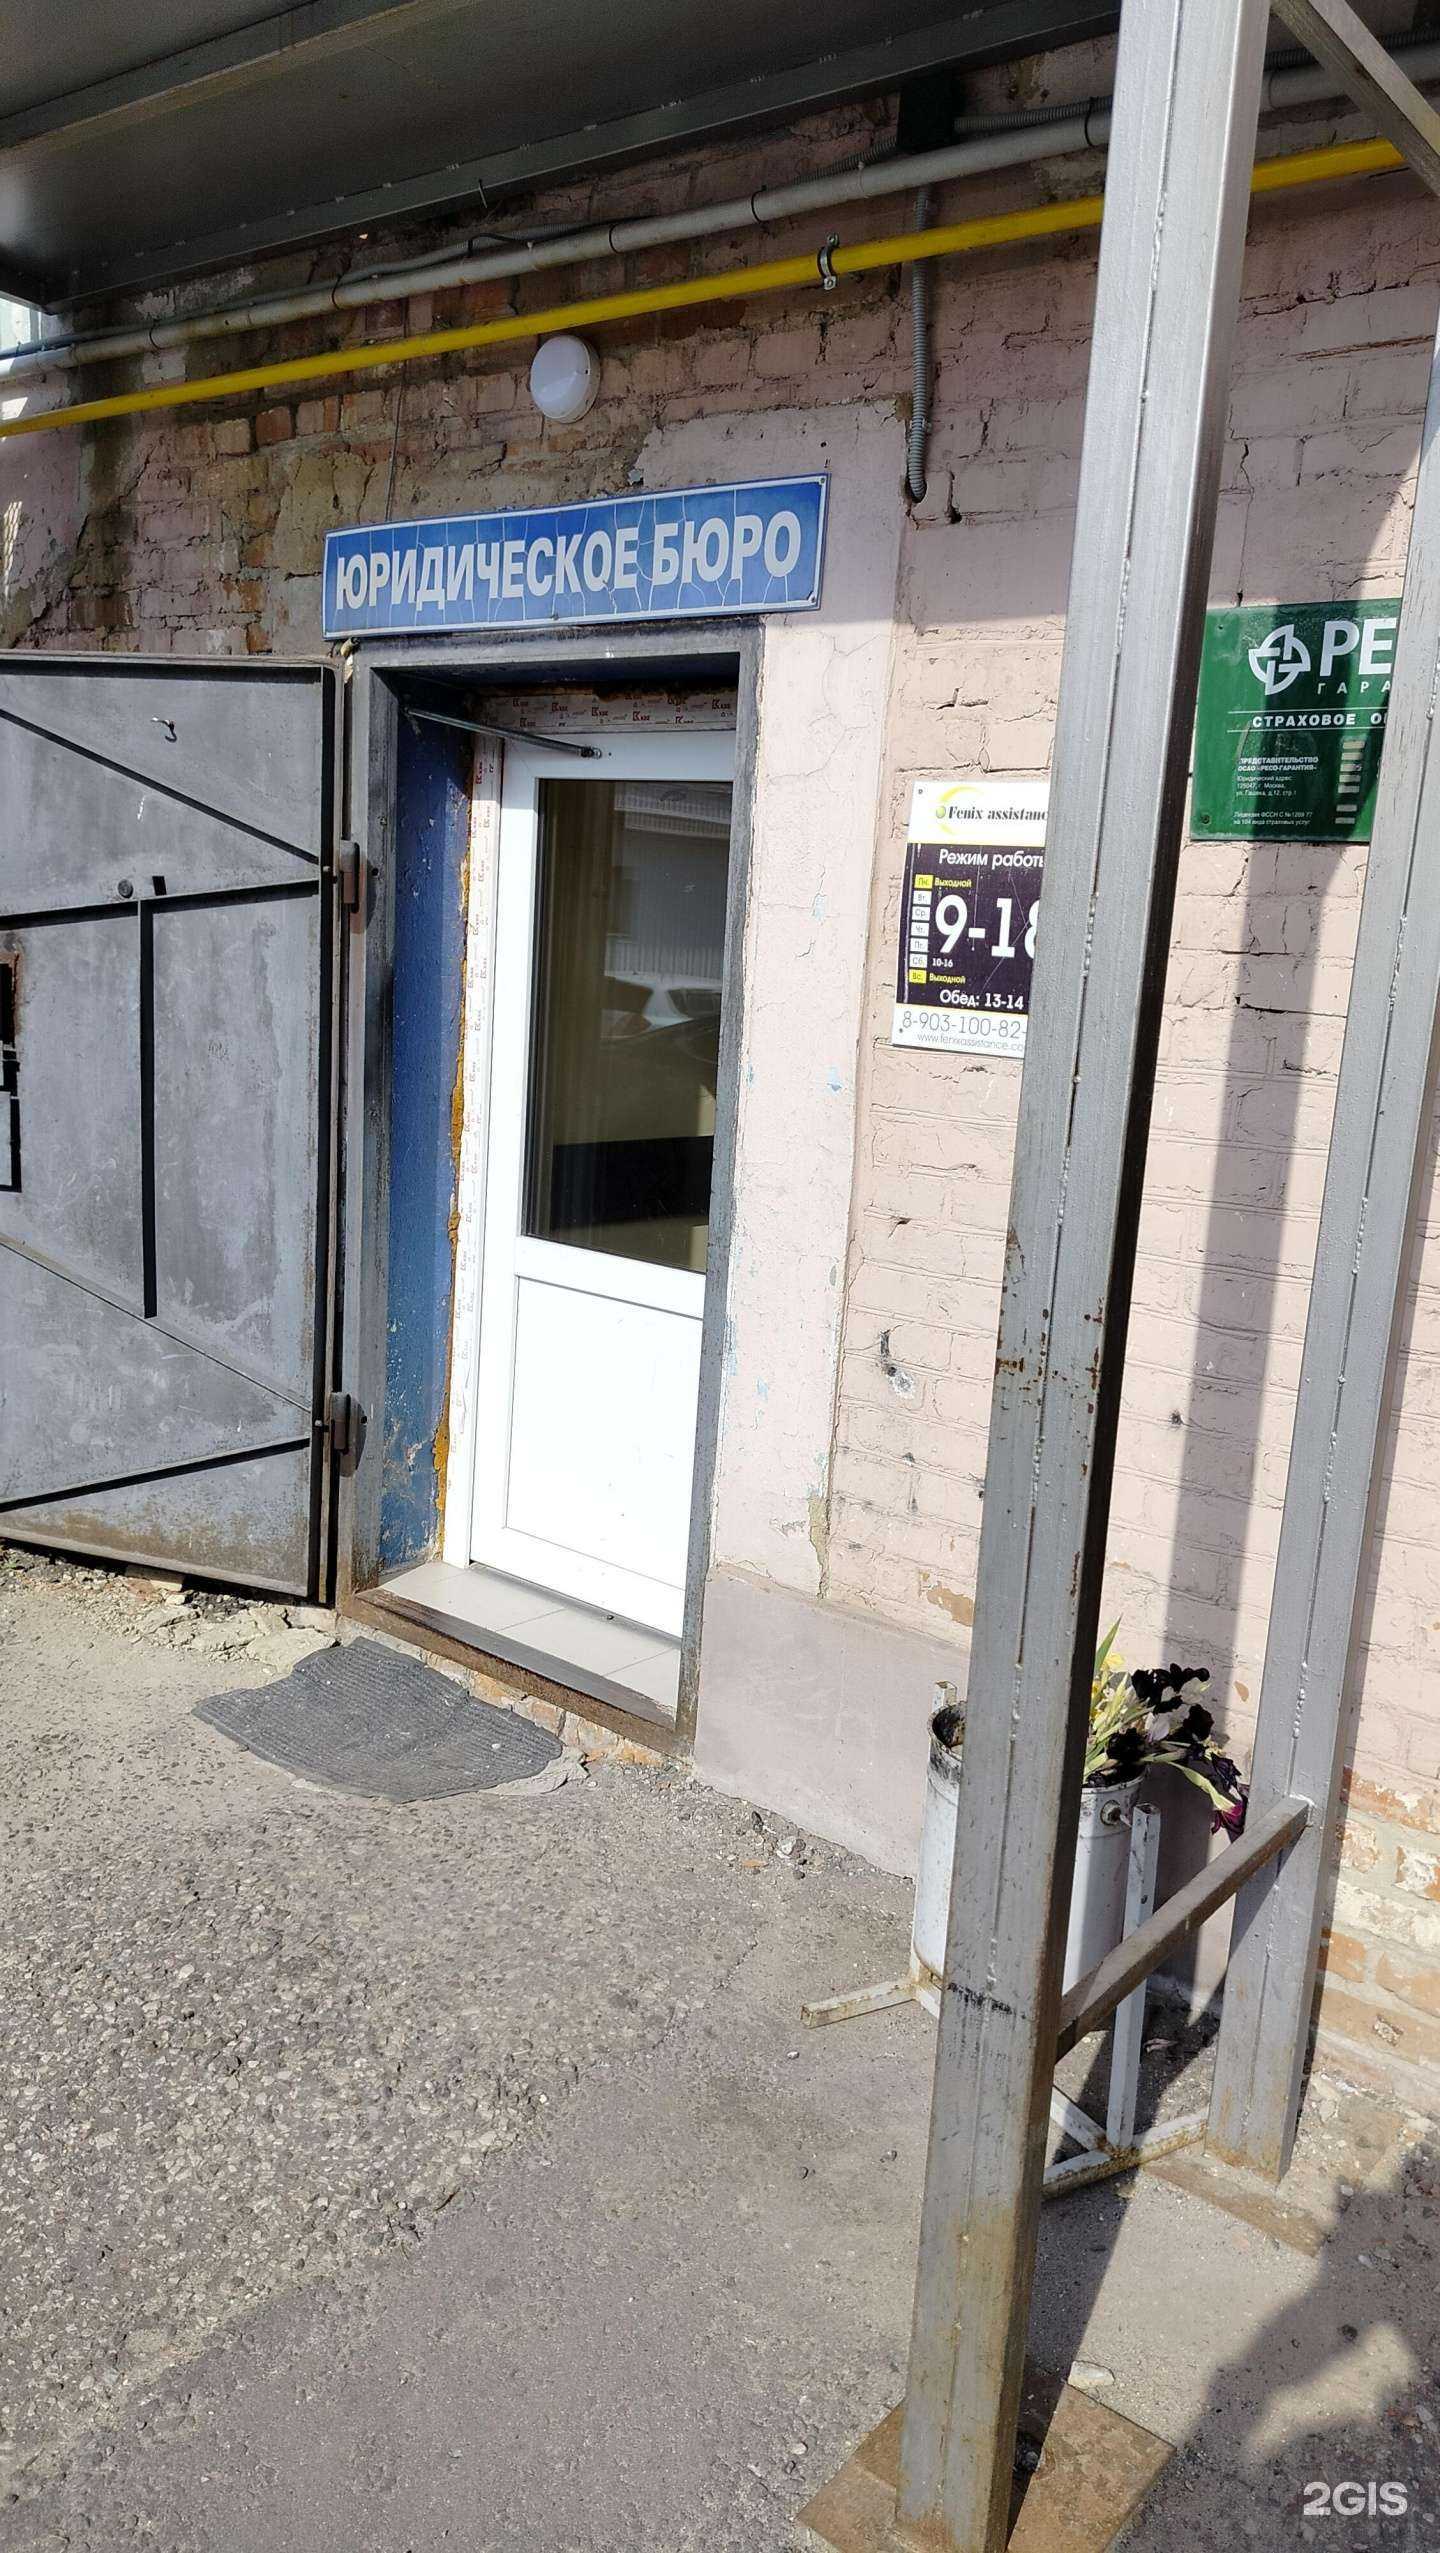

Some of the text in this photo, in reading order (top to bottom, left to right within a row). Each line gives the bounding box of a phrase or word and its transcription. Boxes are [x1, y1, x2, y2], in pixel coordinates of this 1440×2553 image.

[336, 510, 802, 612] ЮРИДИЧЕСКОЕ БЮРО
[1252, 712, 1387, 728] СТРАХОВОЕ О
[948, 805, 984, 820] Fenix
[938, 848, 988, 866] Режим
[934, 877, 972, 889] Выходной
[931, 957, 954, 968] 10-16
[929, 972, 966, 984] Выходной
[939, 989, 1024, 1010] Обед: 13-14
